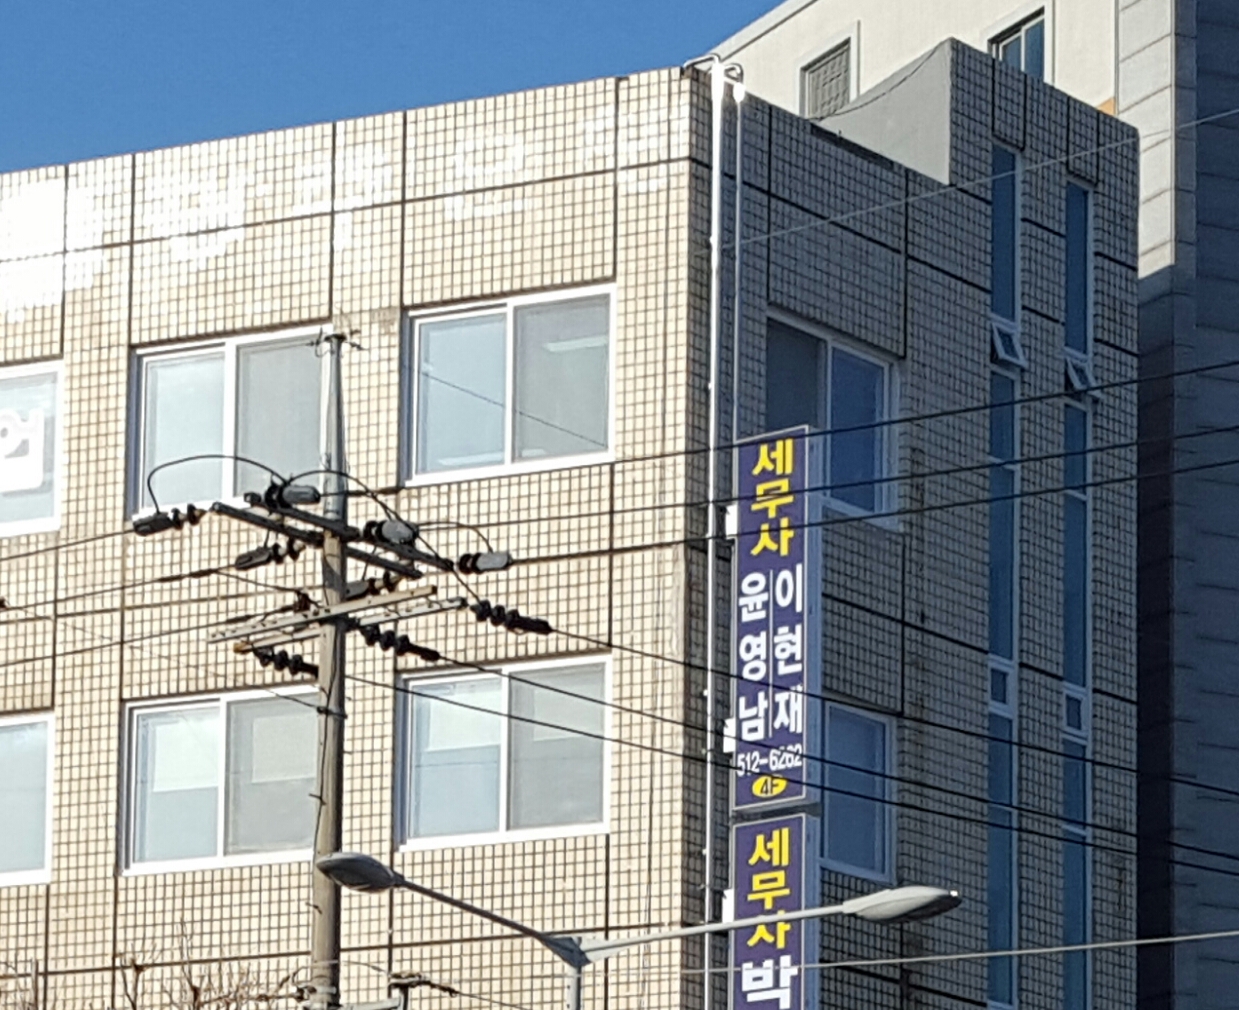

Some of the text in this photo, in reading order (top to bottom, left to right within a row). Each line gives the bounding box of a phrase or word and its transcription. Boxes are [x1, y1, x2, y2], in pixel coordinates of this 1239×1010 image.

[750, 437, 795, 557] 세무사
[738, 571, 769, 743] 윤영남
[773, 563, 803, 735] 이현재
[759, 775, 780, 795] 4F
[746, 827, 791, 949] 세무사
